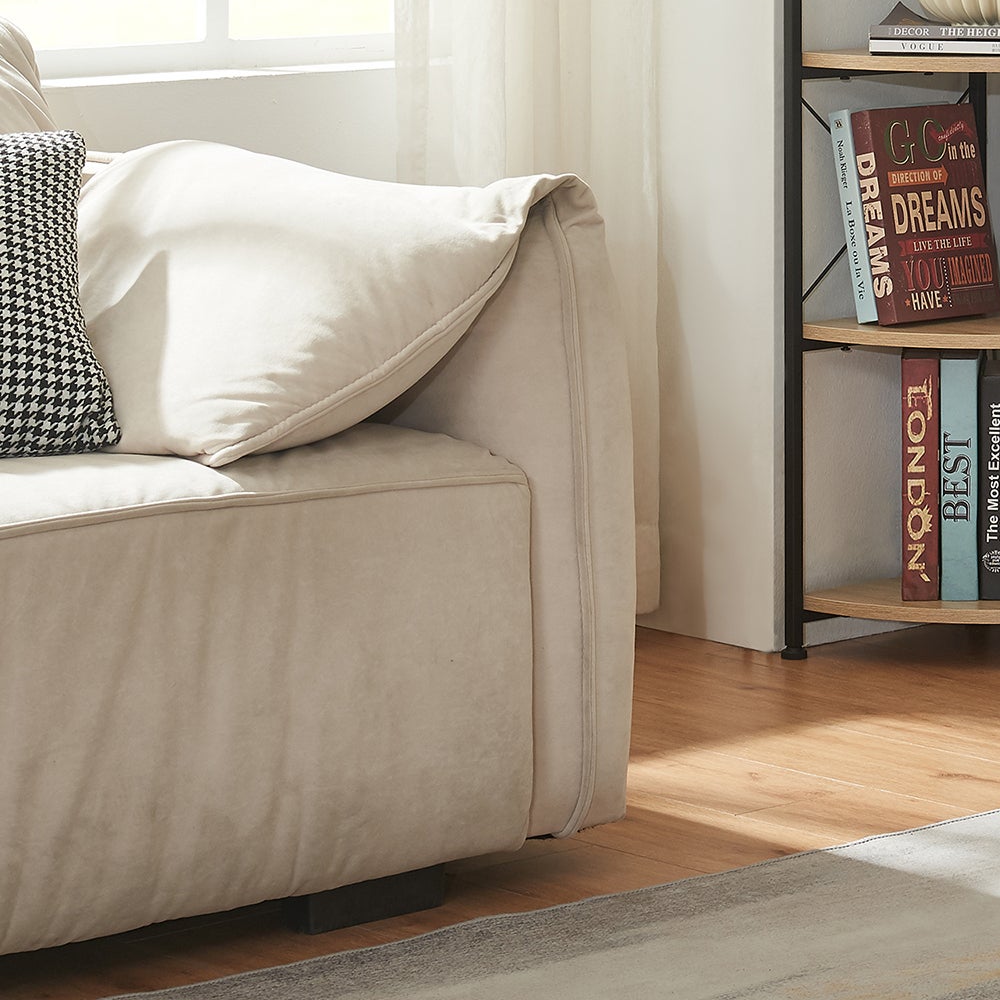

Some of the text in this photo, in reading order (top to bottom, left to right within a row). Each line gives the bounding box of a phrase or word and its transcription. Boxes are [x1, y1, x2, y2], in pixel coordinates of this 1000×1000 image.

[894, 28, 930, 36] DECOR
[940, 28, 964, 36] THE
[901, 42, 944, 51] VOGUE
[836, 140, 848, 189] Noah Klieger
[947, 141, 976, 160] in the
[891, 170, 943, 184] DIRECTION OF
[845, 200, 853, 217] La
[890, 186, 986, 234] DREAMS
[848, 220, 858, 248] Boxe
[856, 152, 894, 298] DREAMS
[913, 236, 972, 251] LIVE THE LIFE
[852, 250, 859, 266] ou
[948, 252, 993, 286] IMAGINED
[854, 267, 862, 279] la
[903, 257, 945, 292] YOU
[911, 290, 943, 310] HAVE
[988, 403, 1000, 471] Excellent
[943, 431, 972, 522] BEST
[987, 475, 1000, 511] Most
[986, 515, 999, 543] The
